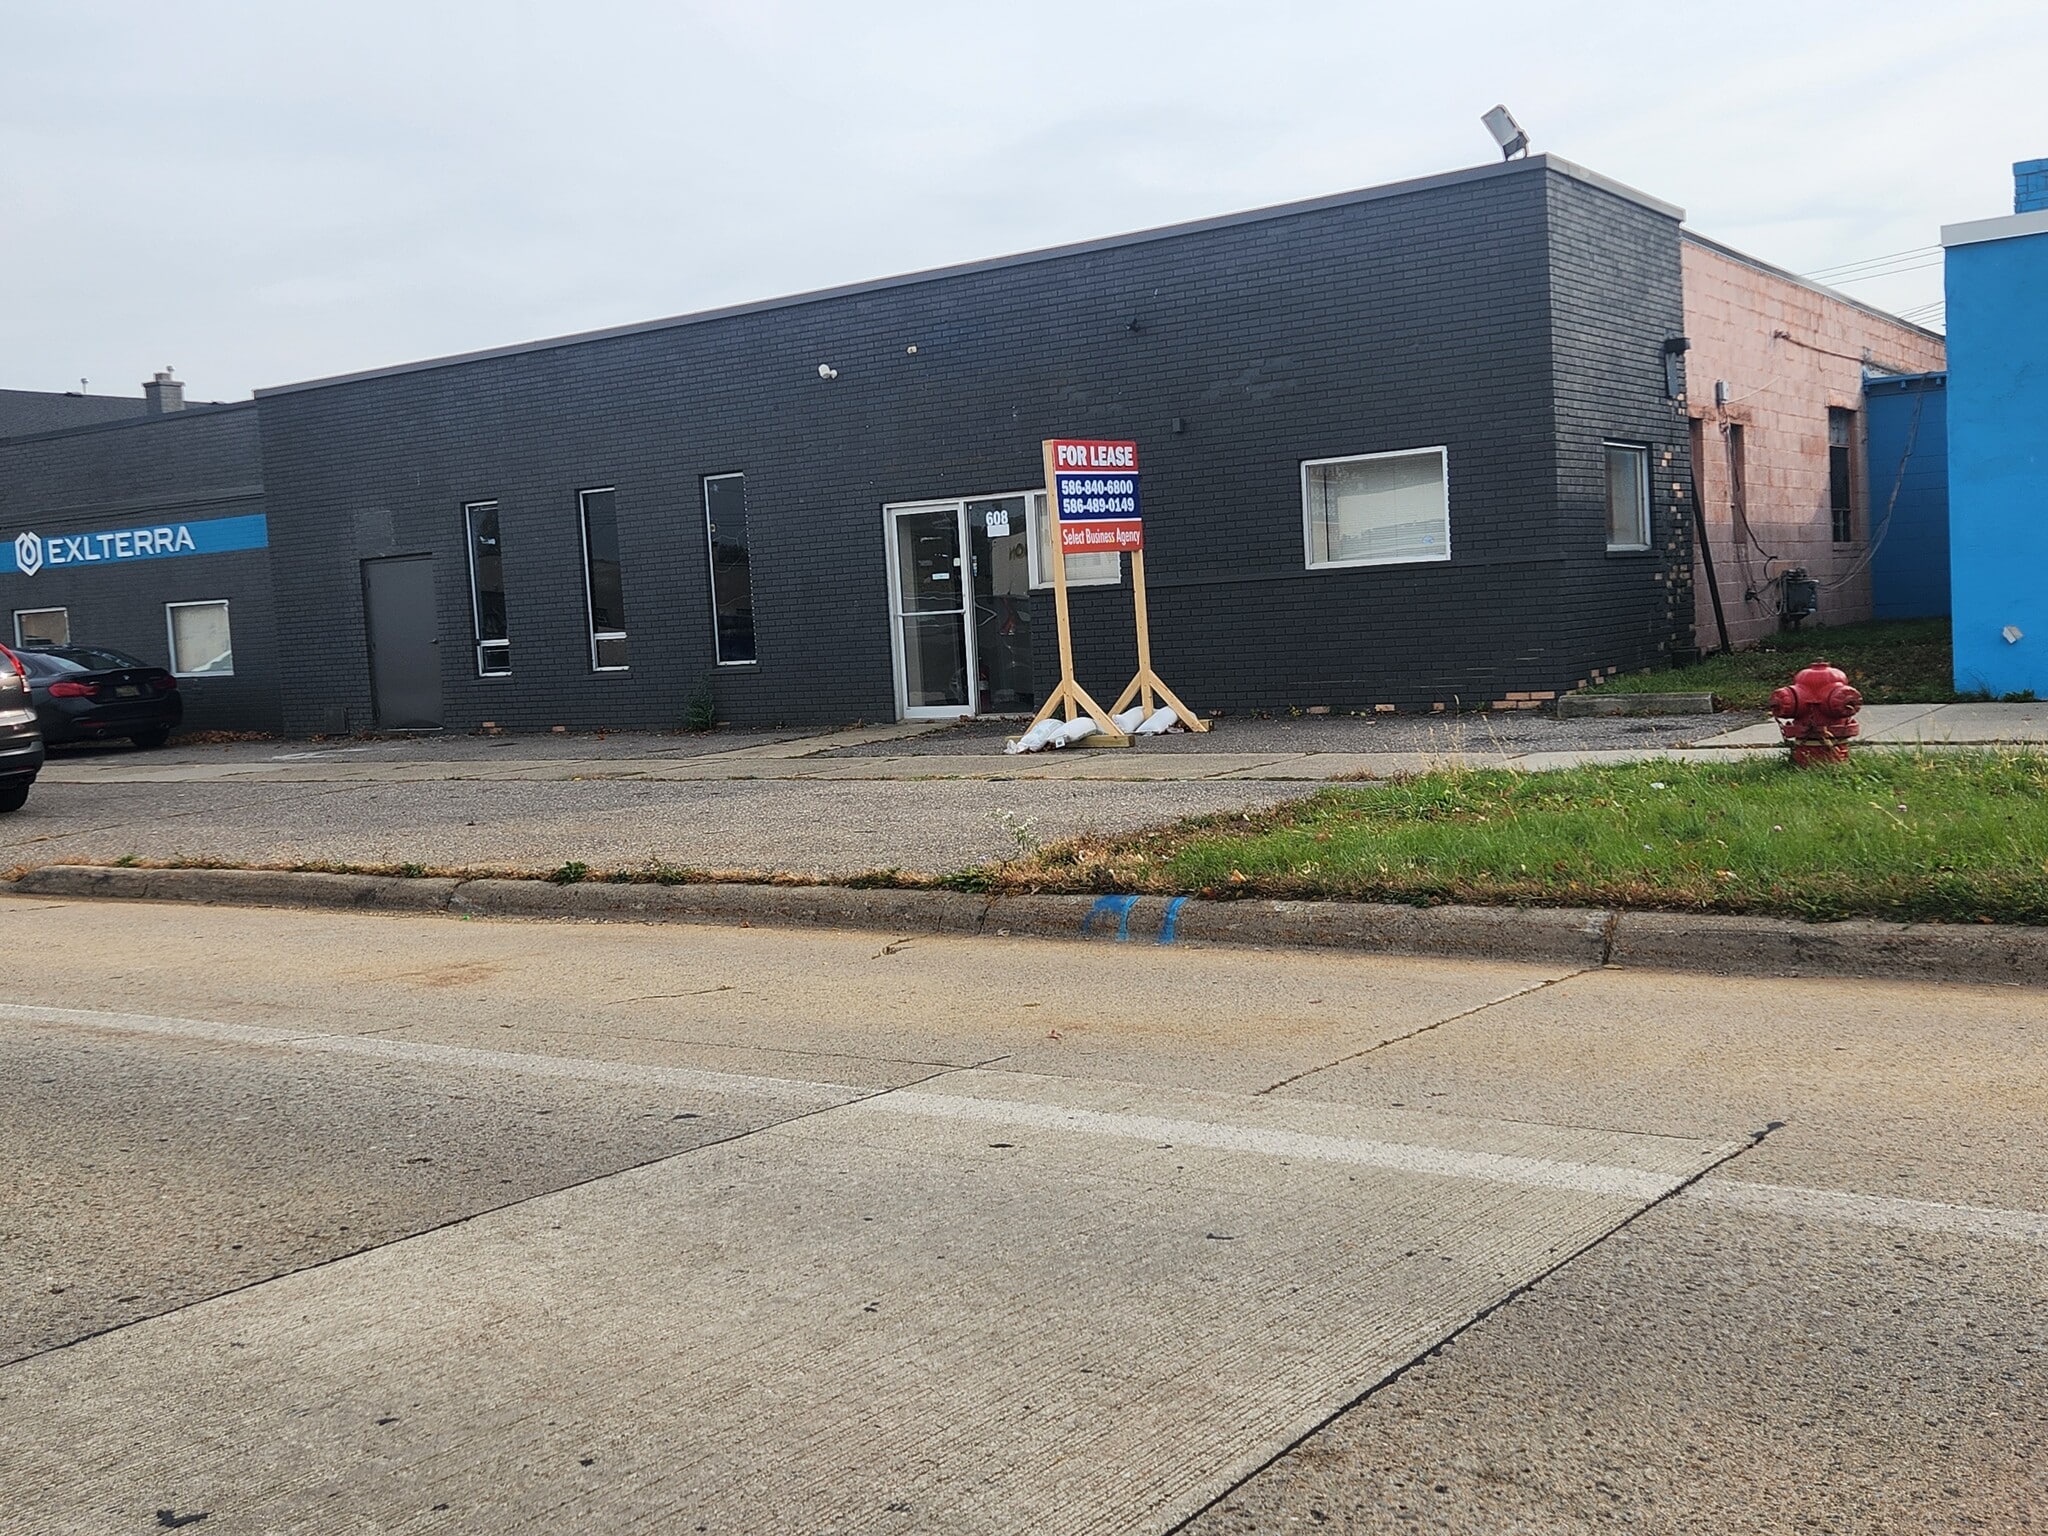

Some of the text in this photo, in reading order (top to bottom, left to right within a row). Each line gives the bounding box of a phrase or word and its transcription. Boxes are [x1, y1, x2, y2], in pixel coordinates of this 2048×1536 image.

[1057, 445, 1134, 467] FOR LEASE
[1061, 480, 1133, 496] 586-840-6800
[1063, 497, 1135, 514] 586-489-0149
[985, 509, 1009, 526] 608
[47, 525, 196, 564] EXLTERRA
[1062, 527, 1141, 546] Select Business Agency
